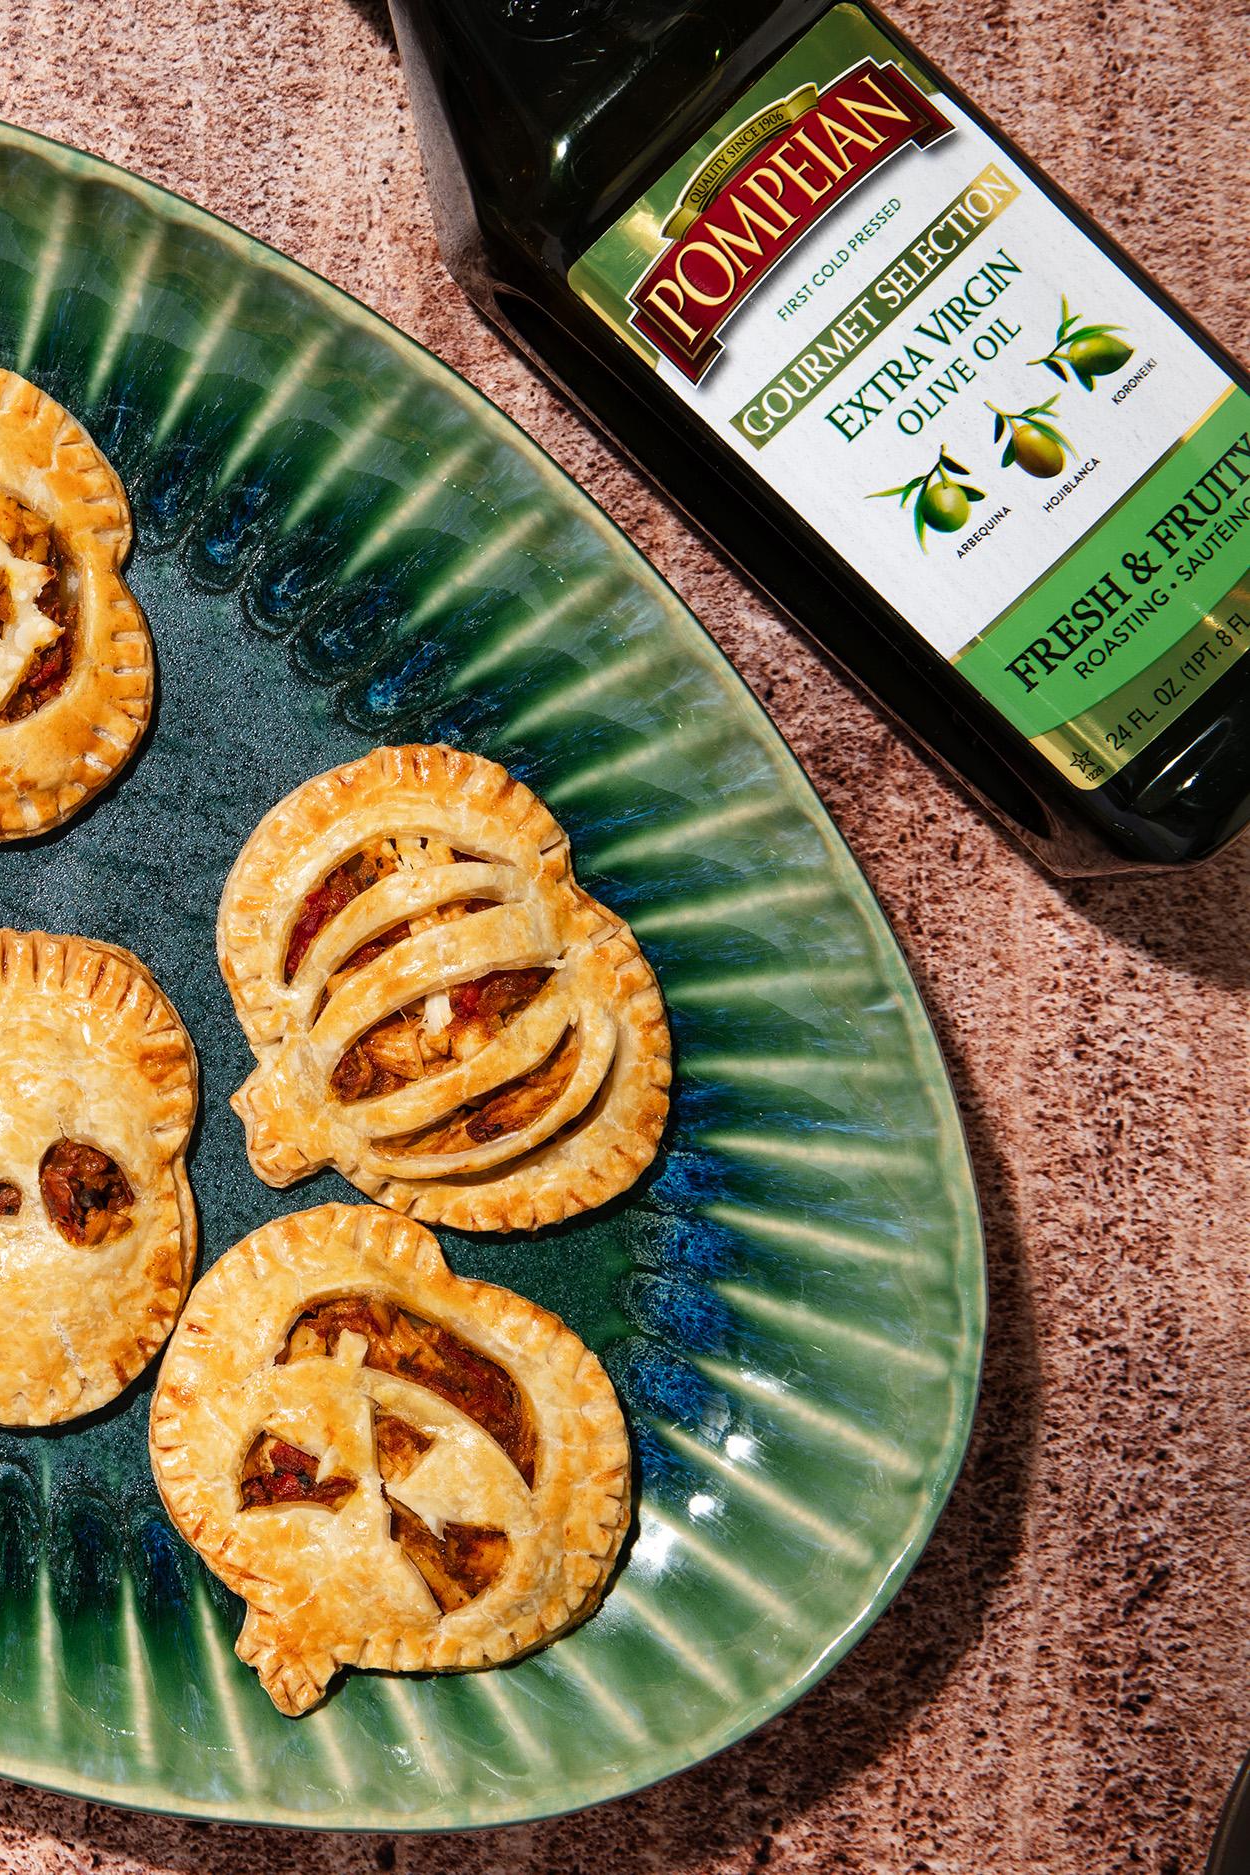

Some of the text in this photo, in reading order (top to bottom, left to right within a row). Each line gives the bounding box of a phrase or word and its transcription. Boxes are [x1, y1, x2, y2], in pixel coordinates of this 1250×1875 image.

[645, 74, 911, 345] POMPEIAN
[690, 110, 784, 203] QUALITY SINCE 1906
[741, 170, 1012, 436] GOURMET SELECTION
[777, 198, 902, 321] FIRST COLD PRESSED
[824, 248, 1023, 442] EXTRA VIRGIN
[897, 317, 1021, 435] OLIVE OIL
[1111, 357, 1158, 406] KORONEIKI
[956, 506, 1012, 559] ARBEQUINA
[1042, 456, 1101, 513] HOJIBLANCA
[1004, 572, 1133, 693] FRESH
[1122, 551, 1162, 584] &
[1073, 588, 1170, 680] ROASTING
[1106, 725, 1132, 750] 24
[1127, 706, 1158, 732] FL.
[1153, 678, 1187, 706] OZ.
[1180, 641, 1222, 681] (1PT.
[1215, 629, 1233, 647] 8
[1085, 765, 1105, 782] 1220
